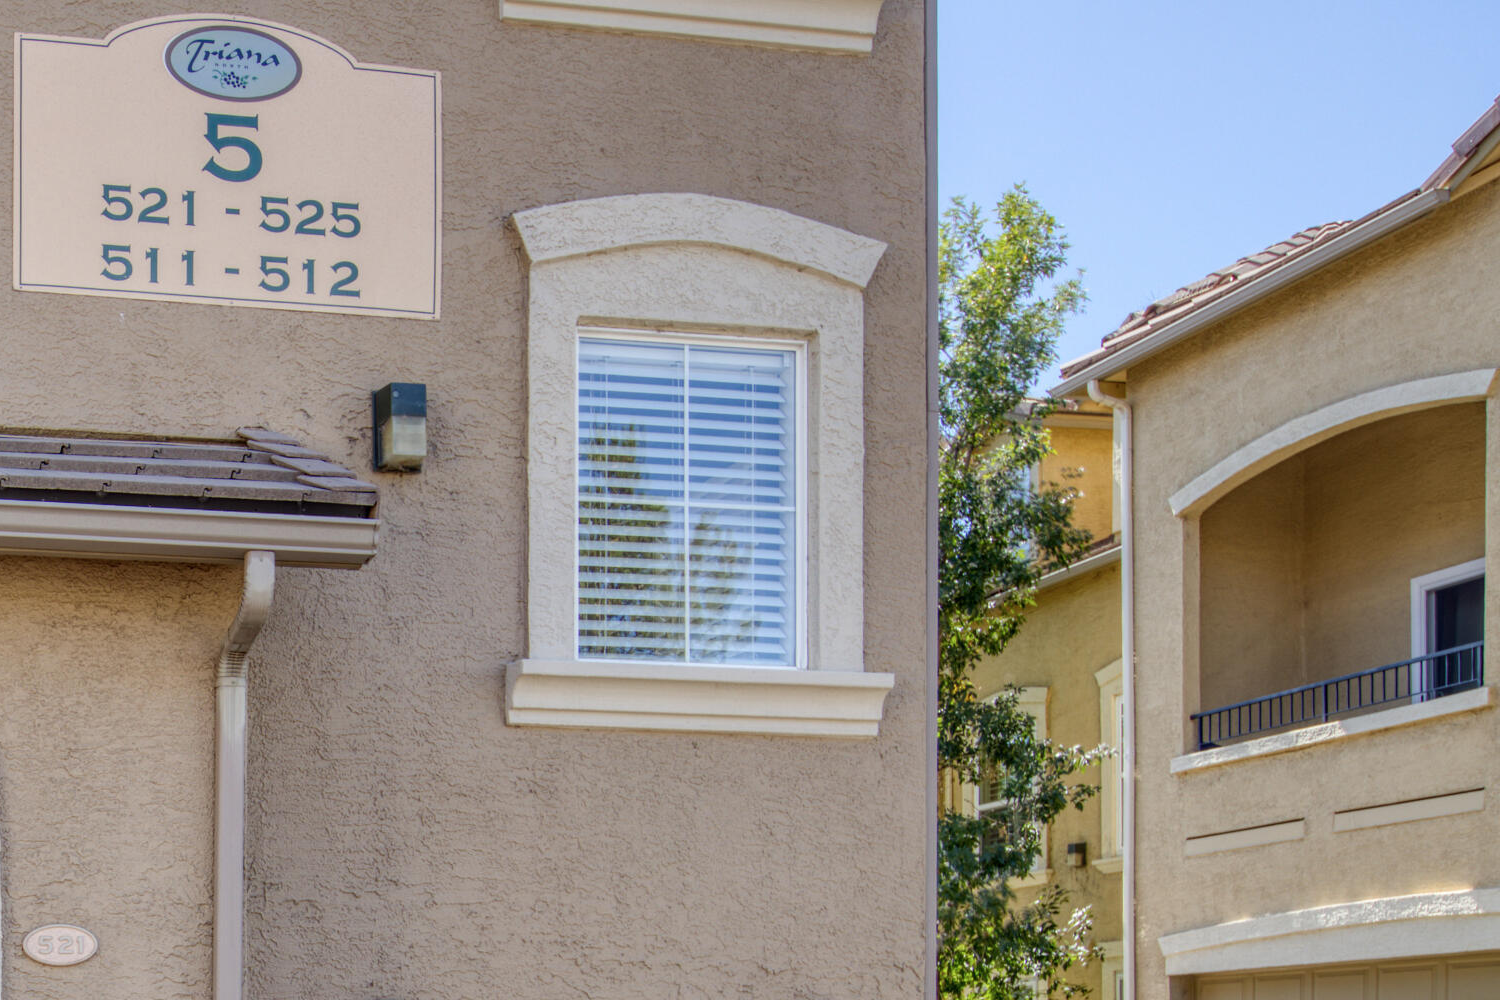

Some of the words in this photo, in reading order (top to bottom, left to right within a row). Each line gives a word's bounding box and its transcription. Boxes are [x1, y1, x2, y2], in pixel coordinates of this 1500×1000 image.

[186, 39, 280, 73] Triana
[202, 112, 263, 182] 5
[101, 183, 196, 226] 521
[259, 196, 361, 239] 525
[100, 244, 196, 286] 511
[259, 255, 361, 299] 512
[38, 935, 85, 954] 521
